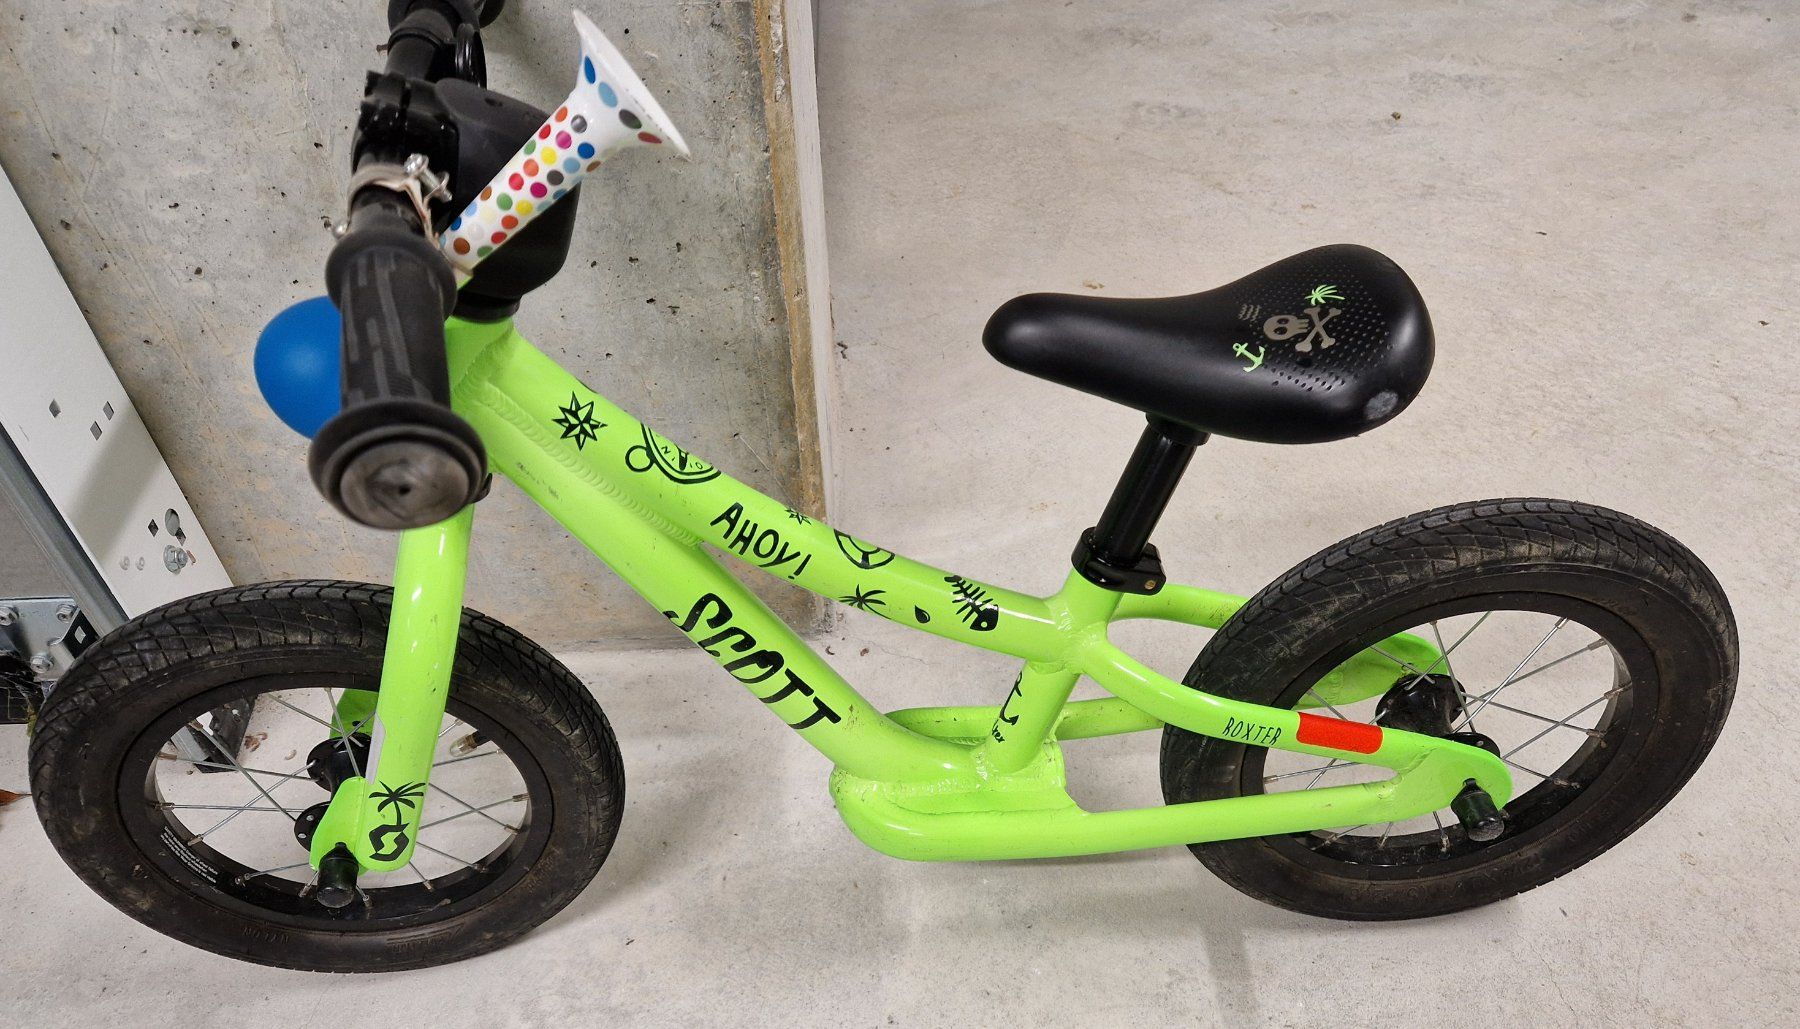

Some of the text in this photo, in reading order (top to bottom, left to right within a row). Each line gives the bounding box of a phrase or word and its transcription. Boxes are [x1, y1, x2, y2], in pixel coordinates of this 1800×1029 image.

[710, 503, 811, 580] AHOY!
[663, 593, 841, 730] SCOTT
[1223, 717, 1281, 745] ROXTER
